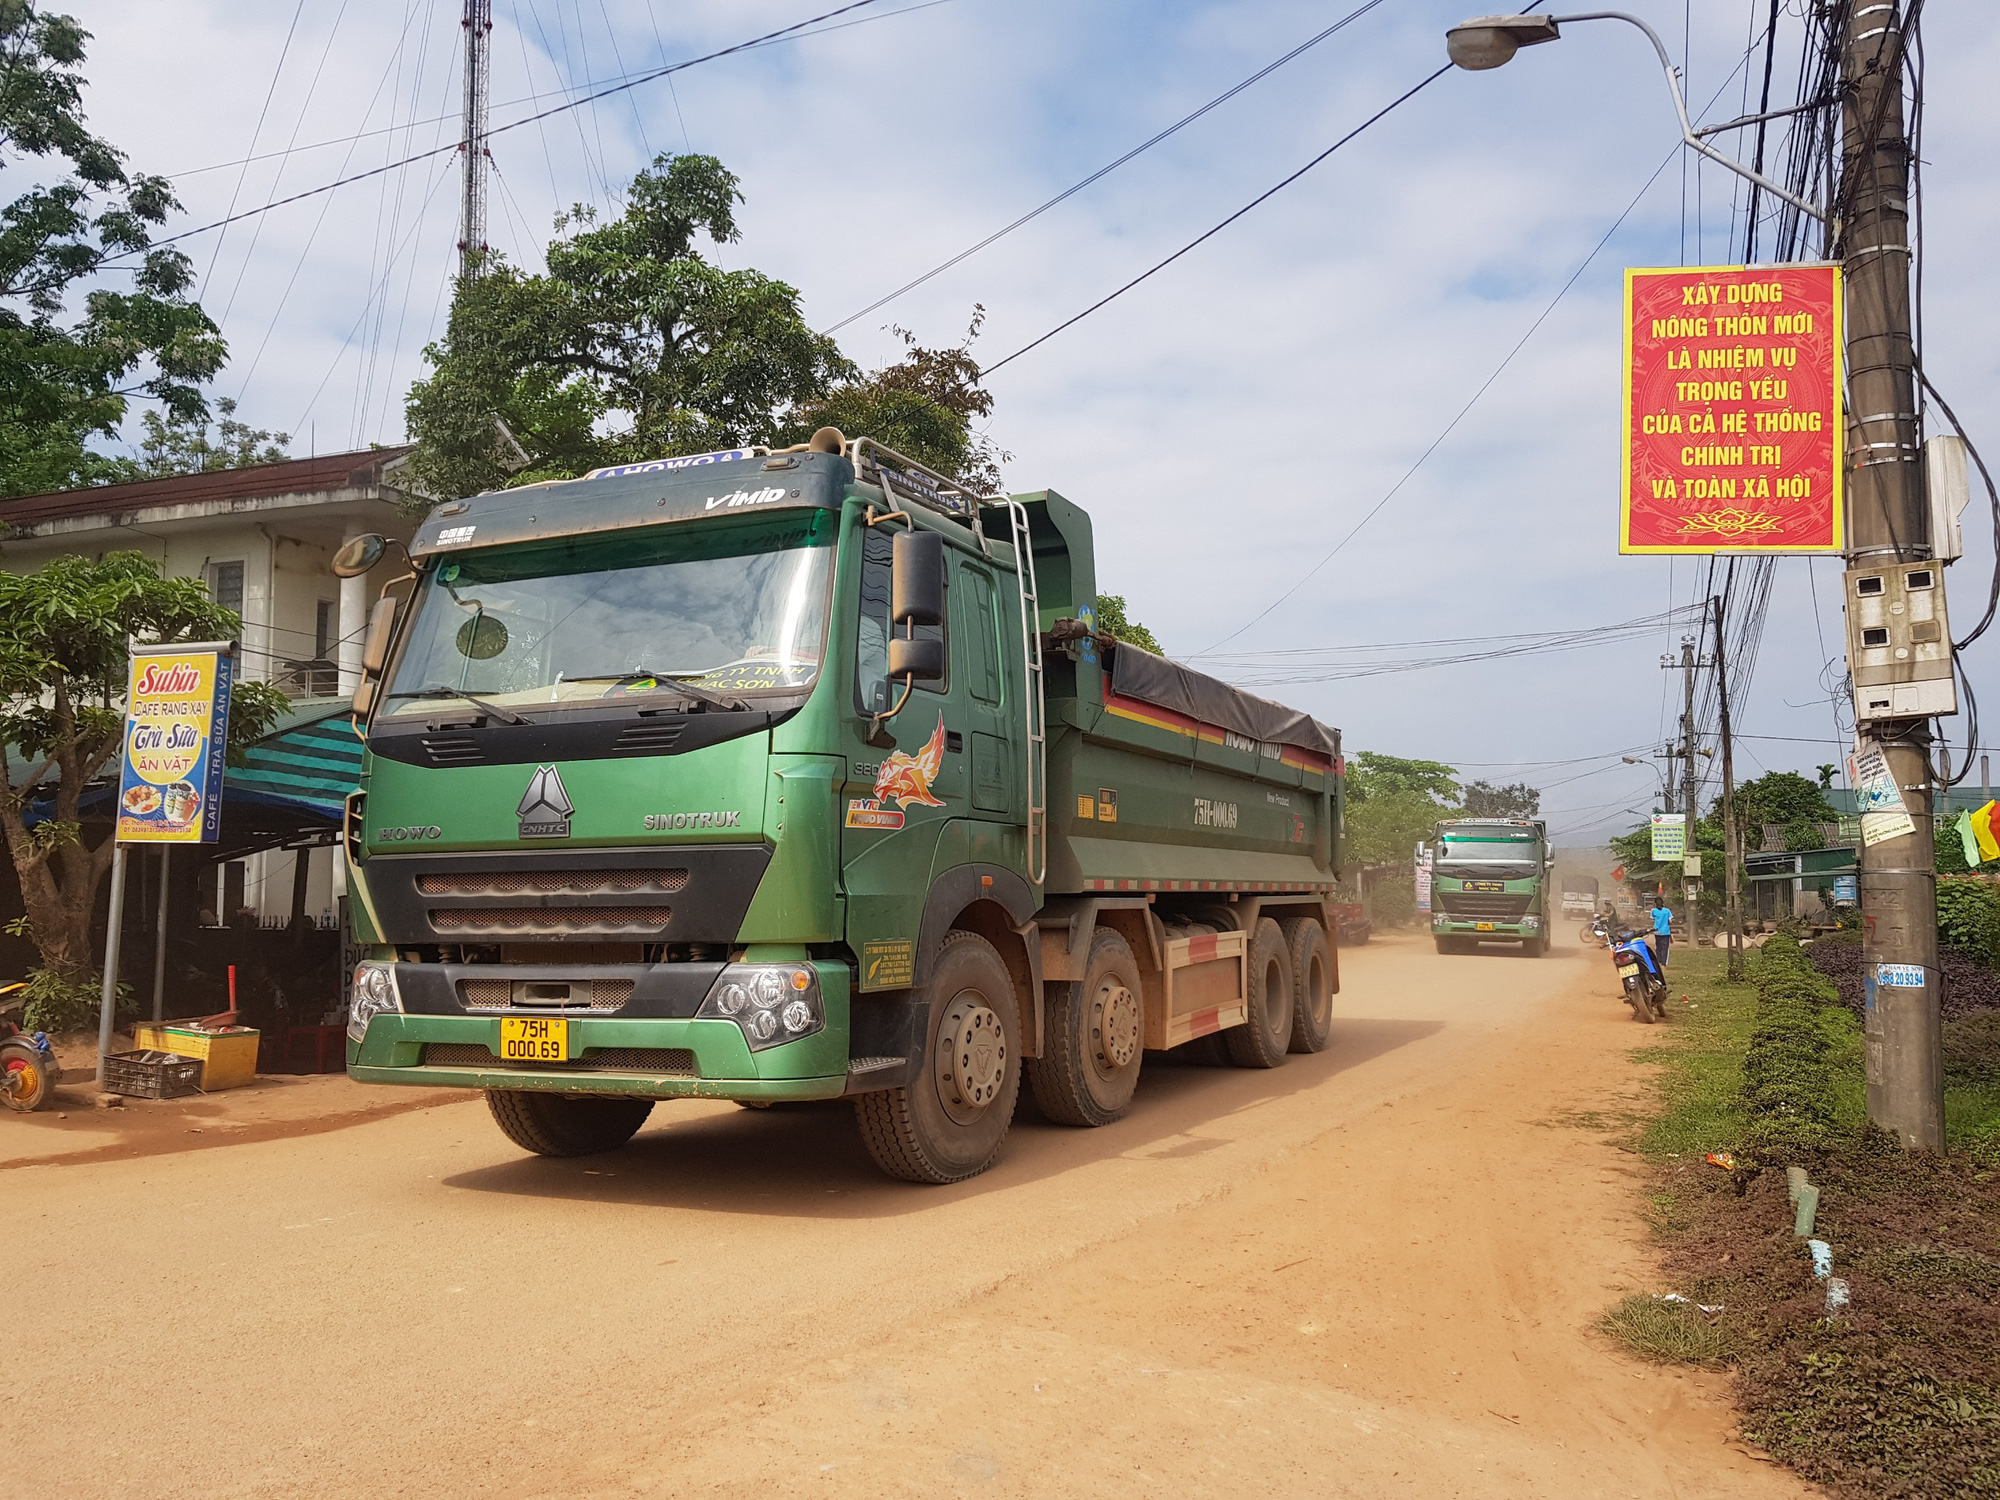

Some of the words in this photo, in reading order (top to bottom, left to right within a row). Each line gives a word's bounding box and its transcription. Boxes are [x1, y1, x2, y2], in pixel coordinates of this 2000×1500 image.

[1681, 282, 1720, 305] XÂY
[1727, 282, 1782, 307] DỰNG
[1652, 315, 1708, 338] NÔNG
[1714, 313, 1767, 336] THÔN
[1774, 310, 1813, 334] MỚI
[1667, 346, 1692, 370] LÀ
[1698, 345, 1764, 372] NHIỆM
[1771, 347, 1797, 371] VỤ
[1676, 381, 1743, 405] TRỌNG
[1749, 374, 1787, 400] YẾU
[1642, 408, 1682, 434] CỦA
[1689, 407, 1716, 434] CẢ
[1722, 409, 1747, 437] HỆ
[1754, 405, 1822, 432] THỐNG
[1681, 442, 1743, 466] CHÍNH
[1749, 445, 1781, 469] TRỊ
[888, 470, 958, 508] SINOTRUK
[1652, 475, 1677, 499] VÀ
[1683, 475, 1736, 498] TOÀN
[1742, 475, 1770, 498] XÃ
[1776, 474, 1811, 502] HỘI
[137, 664, 199, 695] Subin
[218, 663, 229, 690] VẶT
[729, 667, 751, 676] TY
[732, 679, 776, 689] SƠN
[161, 702, 188, 716] RANG
[189, 701, 208, 715] XAY
[216, 694, 226, 713] ĂN
[134, 725, 163, 750] Trà
[166, 723, 198, 749] Sữa
[213, 718, 224, 745] SỮA
[138, 755, 159, 771] ĂN
[163, 755, 191, 775] VẶT
[211, 750, 221, 777] TRÀ
[207, 793, 218, 830] CAFÉ
[643, 811, 741, 830] SINOTRUK
[1194, 798, 1238, 829] 75H-000.69
[378, 825, 442, 842] HOWO
[521, 824, 566, 834] CNHTC
[520, 1020, 548, 1038] 75H
[508, 1040, 560, 1058] 000.69
